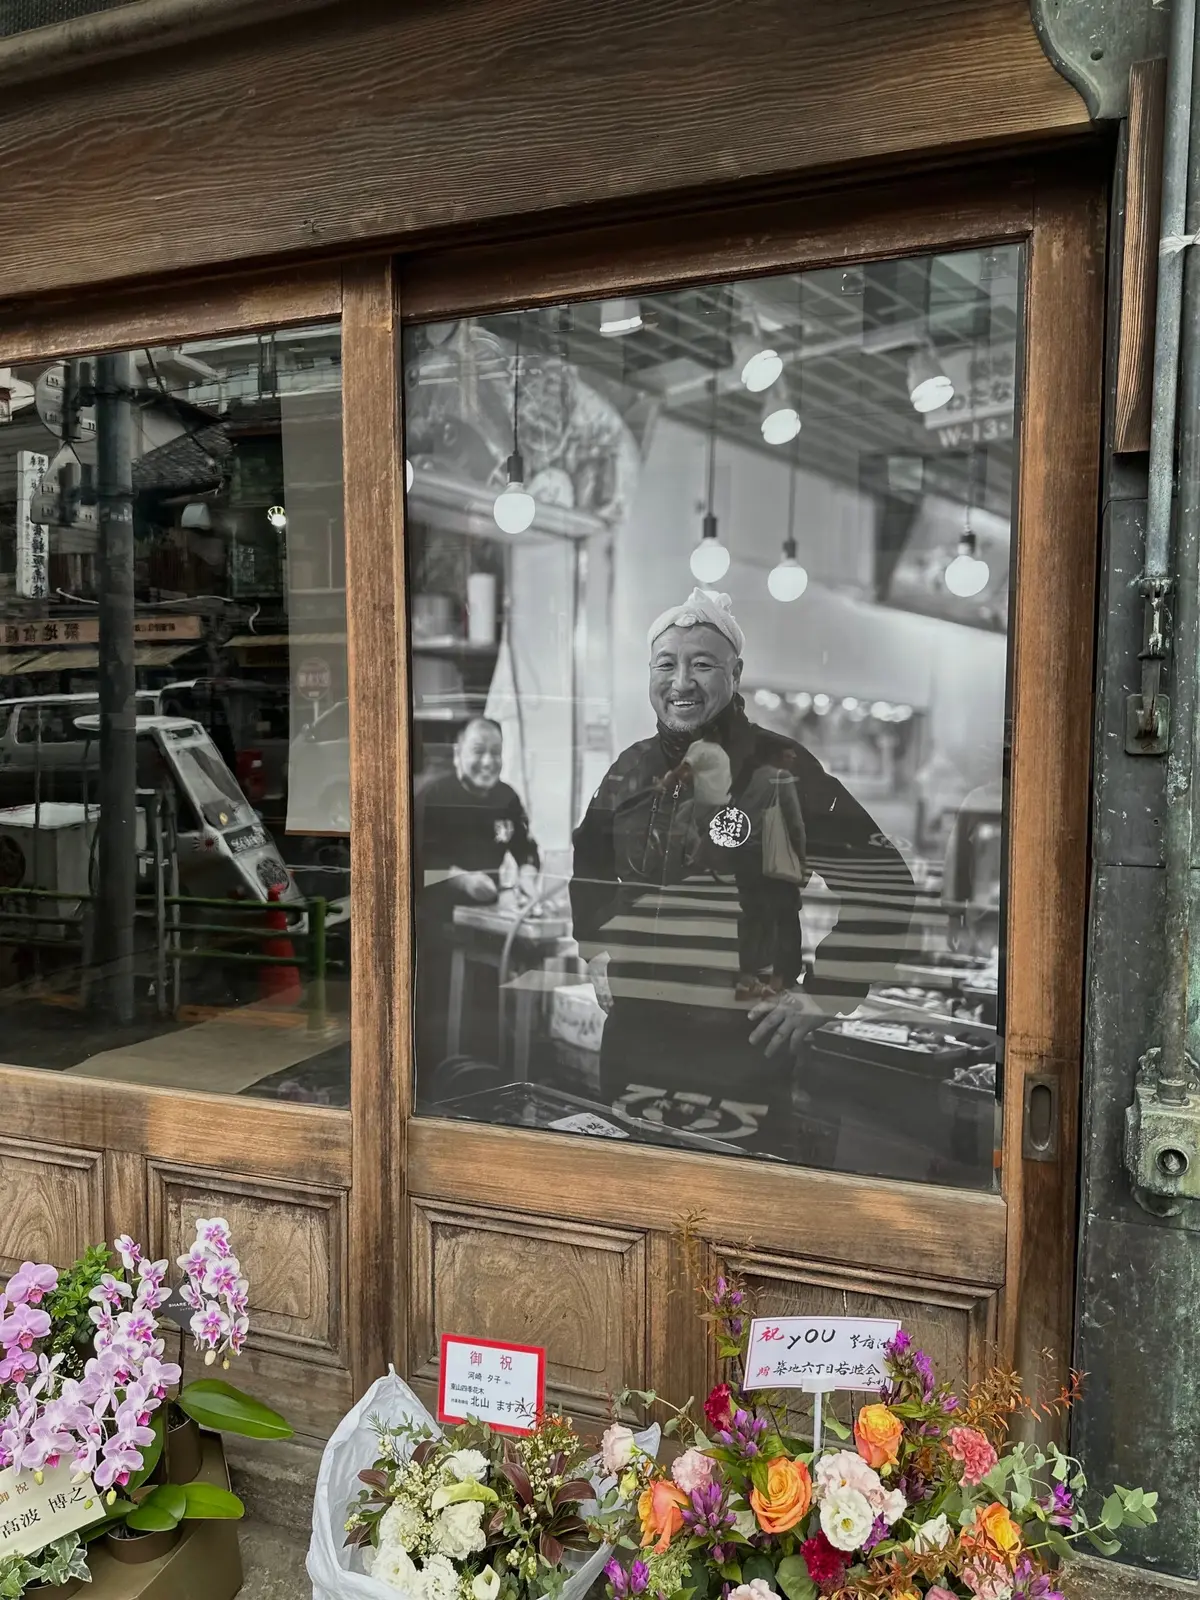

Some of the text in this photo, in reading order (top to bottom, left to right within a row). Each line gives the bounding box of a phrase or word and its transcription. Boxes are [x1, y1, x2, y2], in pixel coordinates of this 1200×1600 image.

[757, 1326, 785, 1342] 祝
[470, 1351, 513, 1371] 御 祝
[470, 1396, 490, 1409] 北山
[15, 1481, 29, 1495] 祝
[0, 1486, 88, 1538] 高波 博之
